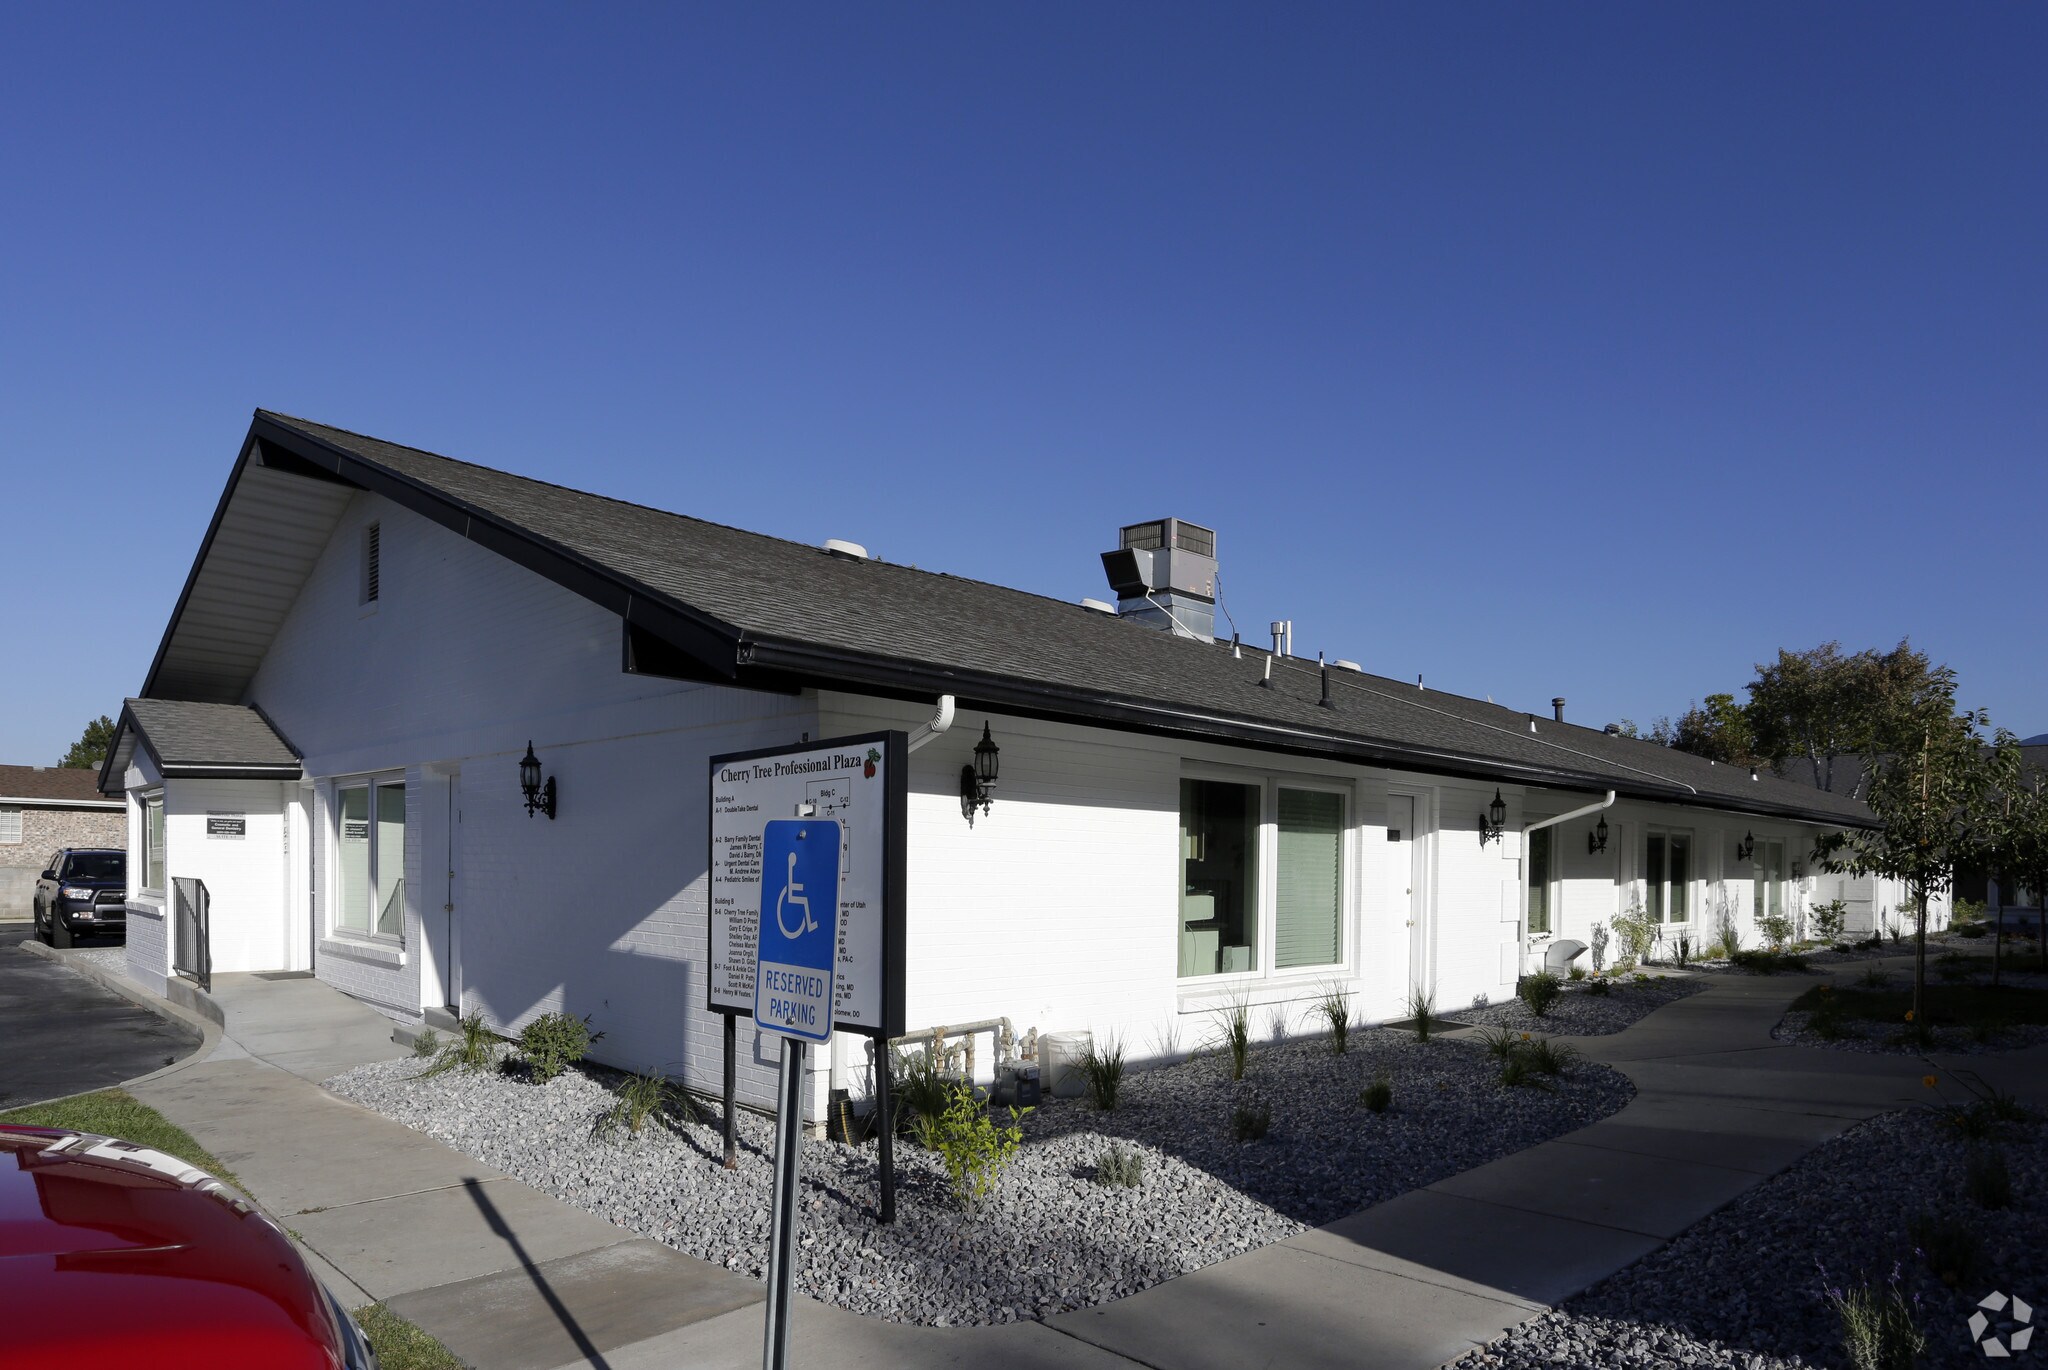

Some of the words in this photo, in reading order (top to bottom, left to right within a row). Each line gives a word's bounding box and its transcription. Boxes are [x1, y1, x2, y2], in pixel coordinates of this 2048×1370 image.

[721, 768, 750, 783] Cherry
[753, 765, 772, 779] Tree
[775, 757, 831, 776] Professional
[834, 755, 861, 769] Plaza
[723, 988, 733, 996] Henry
[766, 970, 822, 998] RESERVED
[770, 999, 815, 1025] PARKING
